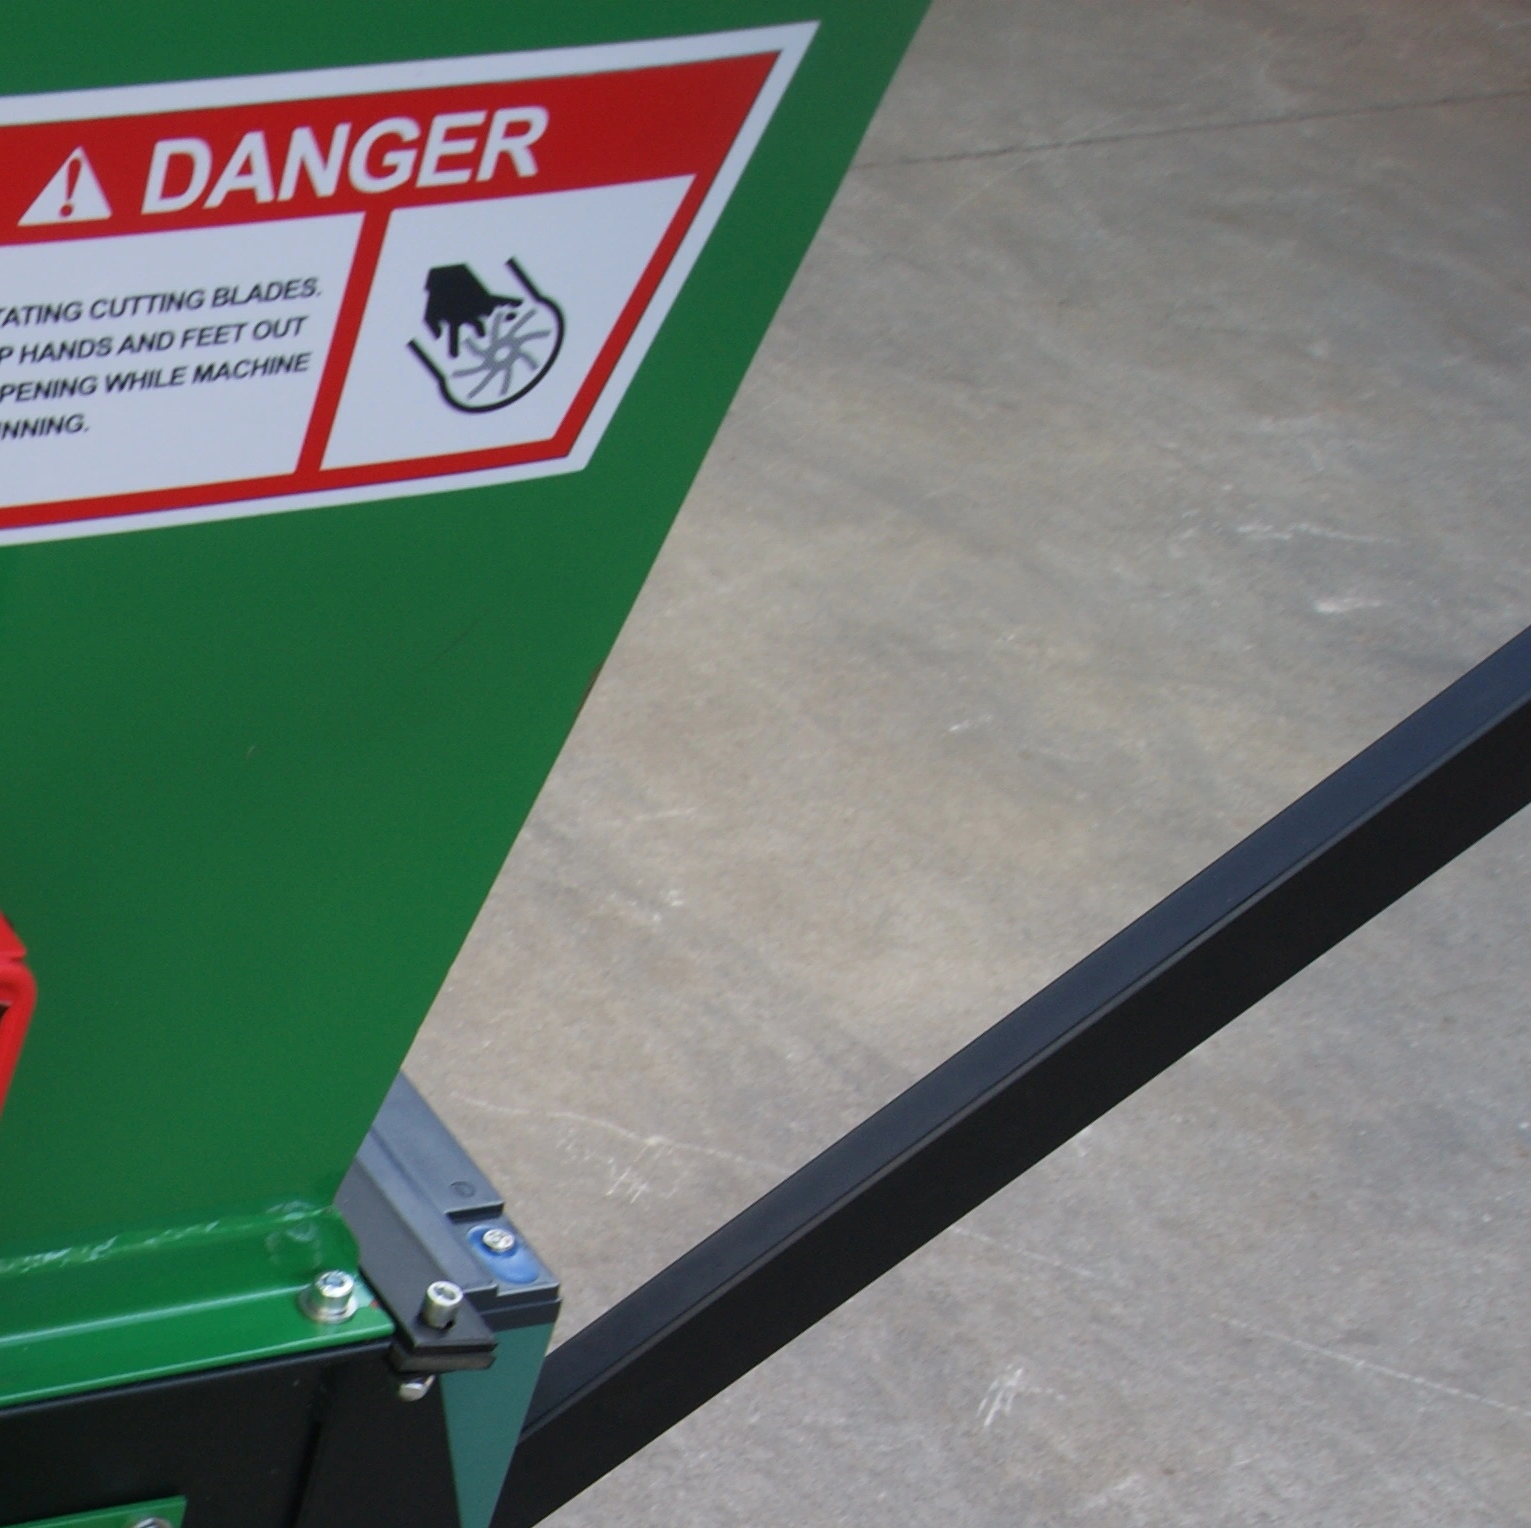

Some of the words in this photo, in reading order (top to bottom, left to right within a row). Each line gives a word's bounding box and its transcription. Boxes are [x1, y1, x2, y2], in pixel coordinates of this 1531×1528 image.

[141, 106, 548, 214] DANGER
[89, 287, 206, 322] CUTTING
[212, 275, 323, 308] BLADES.
[19, 334, 112, 362] HANDS
[116, 328, 175, 354] AND
[182, 322, 248, 350] FEET
[253, 315, 309, 344] OUT
[105, 366, 189, 393] WHILE
[193, 352, 311, 386] MACHINE
